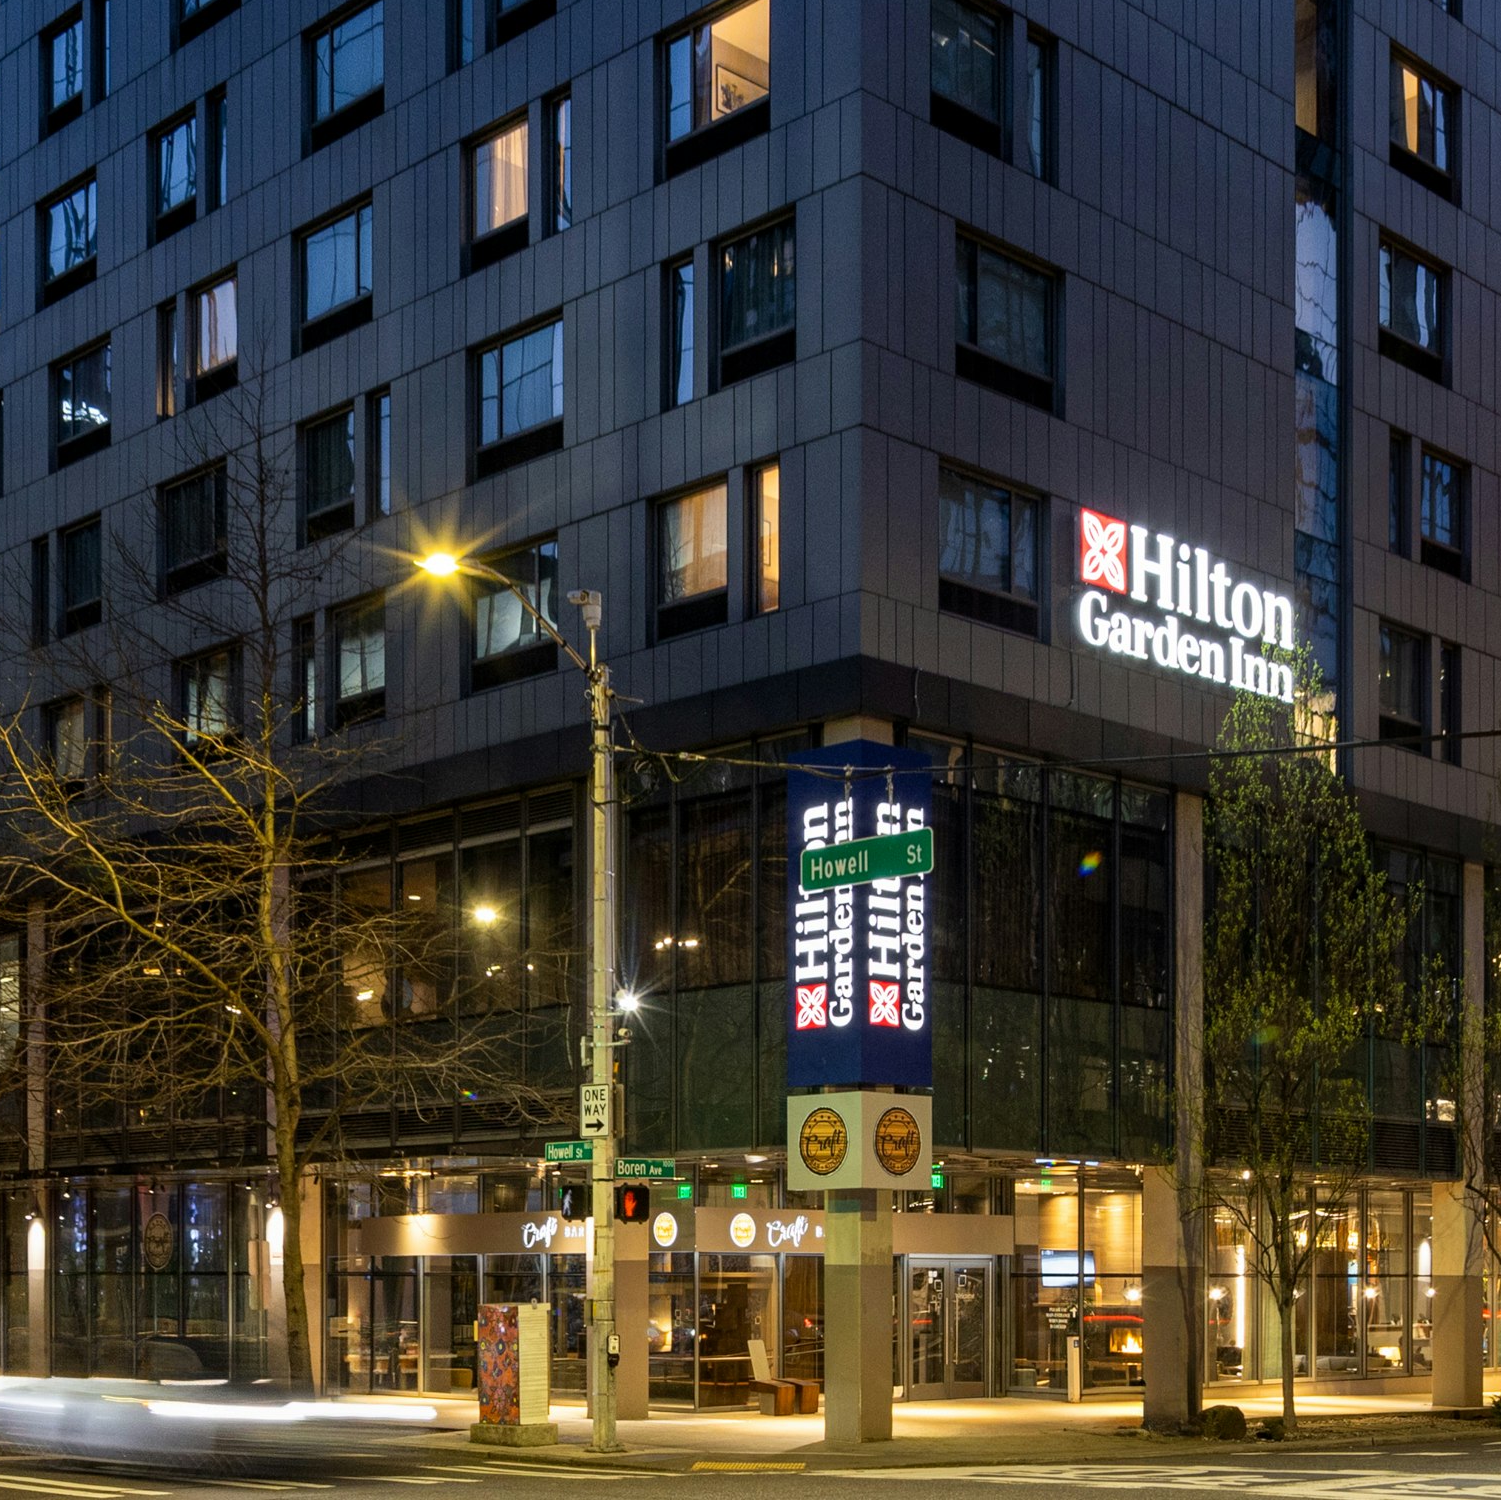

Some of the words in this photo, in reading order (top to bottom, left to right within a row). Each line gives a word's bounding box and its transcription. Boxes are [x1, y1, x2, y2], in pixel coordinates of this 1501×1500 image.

[1129, 524, 1296, 651] Hilton
[1077, 590, 1226, 685] Garden
[1228, 636, 1295, 704] Inn
[810, 849, 869, 882] Howell
[906, 844, 923, 865] St
[795, 802, 829, 980] Hiln
[867, 802, 901, 981] Hiltn
[902, 882, 925, 1032] Garden
[583, 1089, 606, 1102] ONE
[583, 1103, 607, 1117] WAY
[547, 1145, 573, 1160] Howell
[576, 1150, 583, 1159] St
[805, 1128, 843, 1158] Craft
[879, 1128, 917, 1158] Craft
[617, 1160, 646, 1175] Boren
[649, 1166, 662, 1175] Ave
[521, 1216, 558, 1249] Craft
[564, 1225, 586, 1239] BAR
[766, 1215, 809, 1248] Craft
